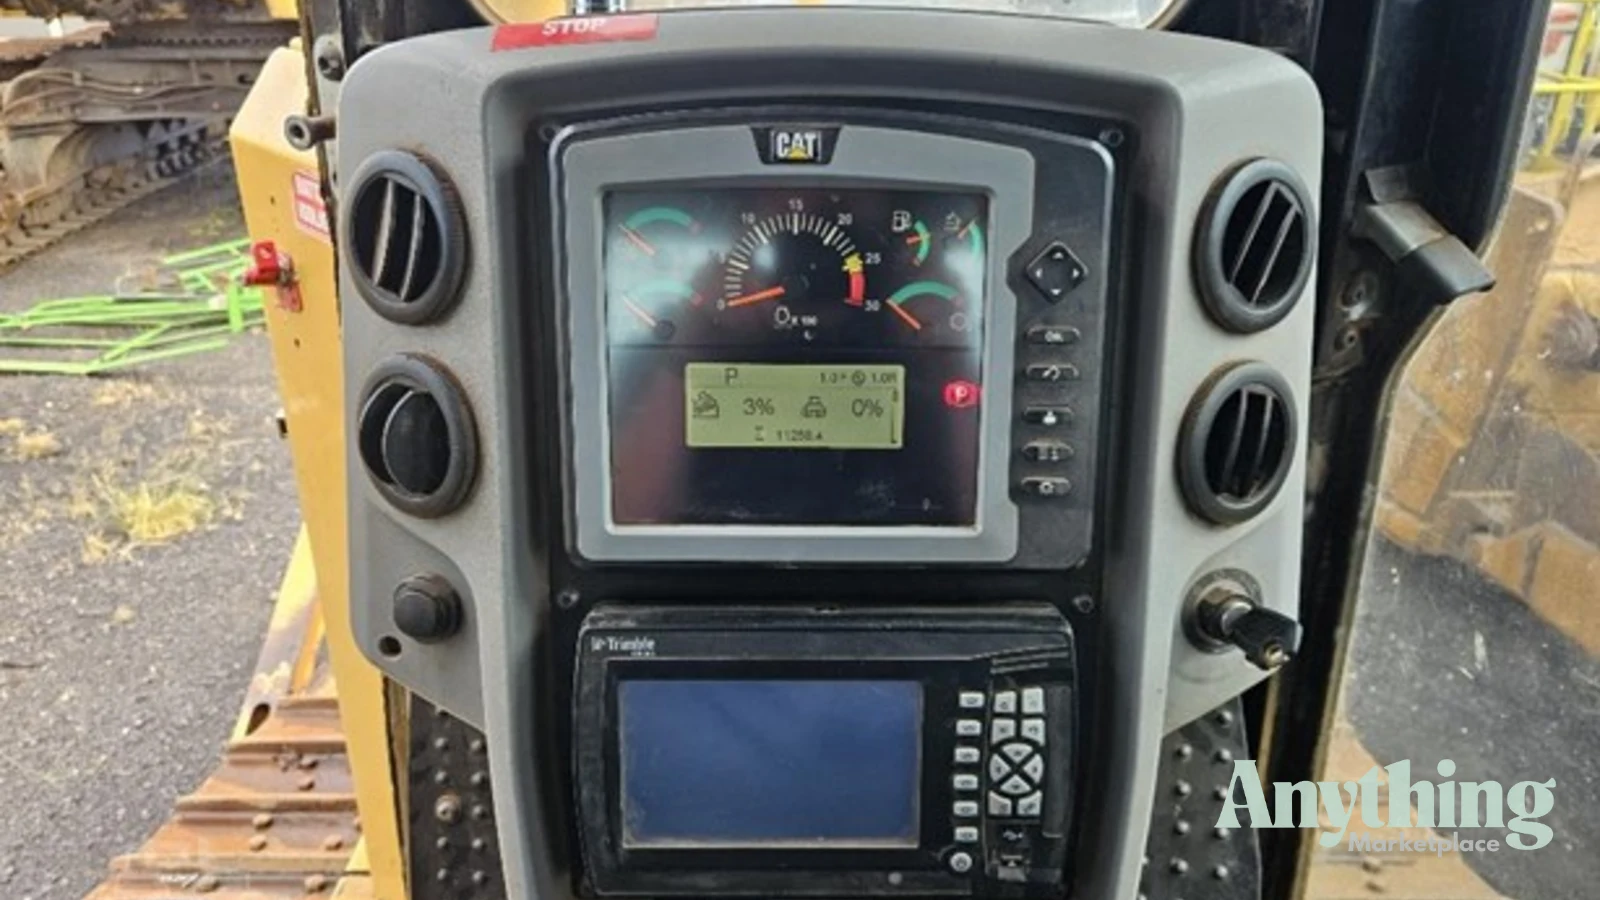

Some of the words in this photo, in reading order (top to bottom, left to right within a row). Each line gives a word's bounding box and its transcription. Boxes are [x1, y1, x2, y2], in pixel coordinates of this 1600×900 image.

[541, 18, 608, 37] STOP
[776, 131, 817, 160] CAT
[837, 213, 853, 226] 20
[865, 252, 881, 265] 25
[864, 299, 881, 312] 30
[724, 367, 739, 385] P
[742, 397, 776, 417] 3%
[851, 398, 884, 419] 0%
[606, 636, 656, 651] Trimble
